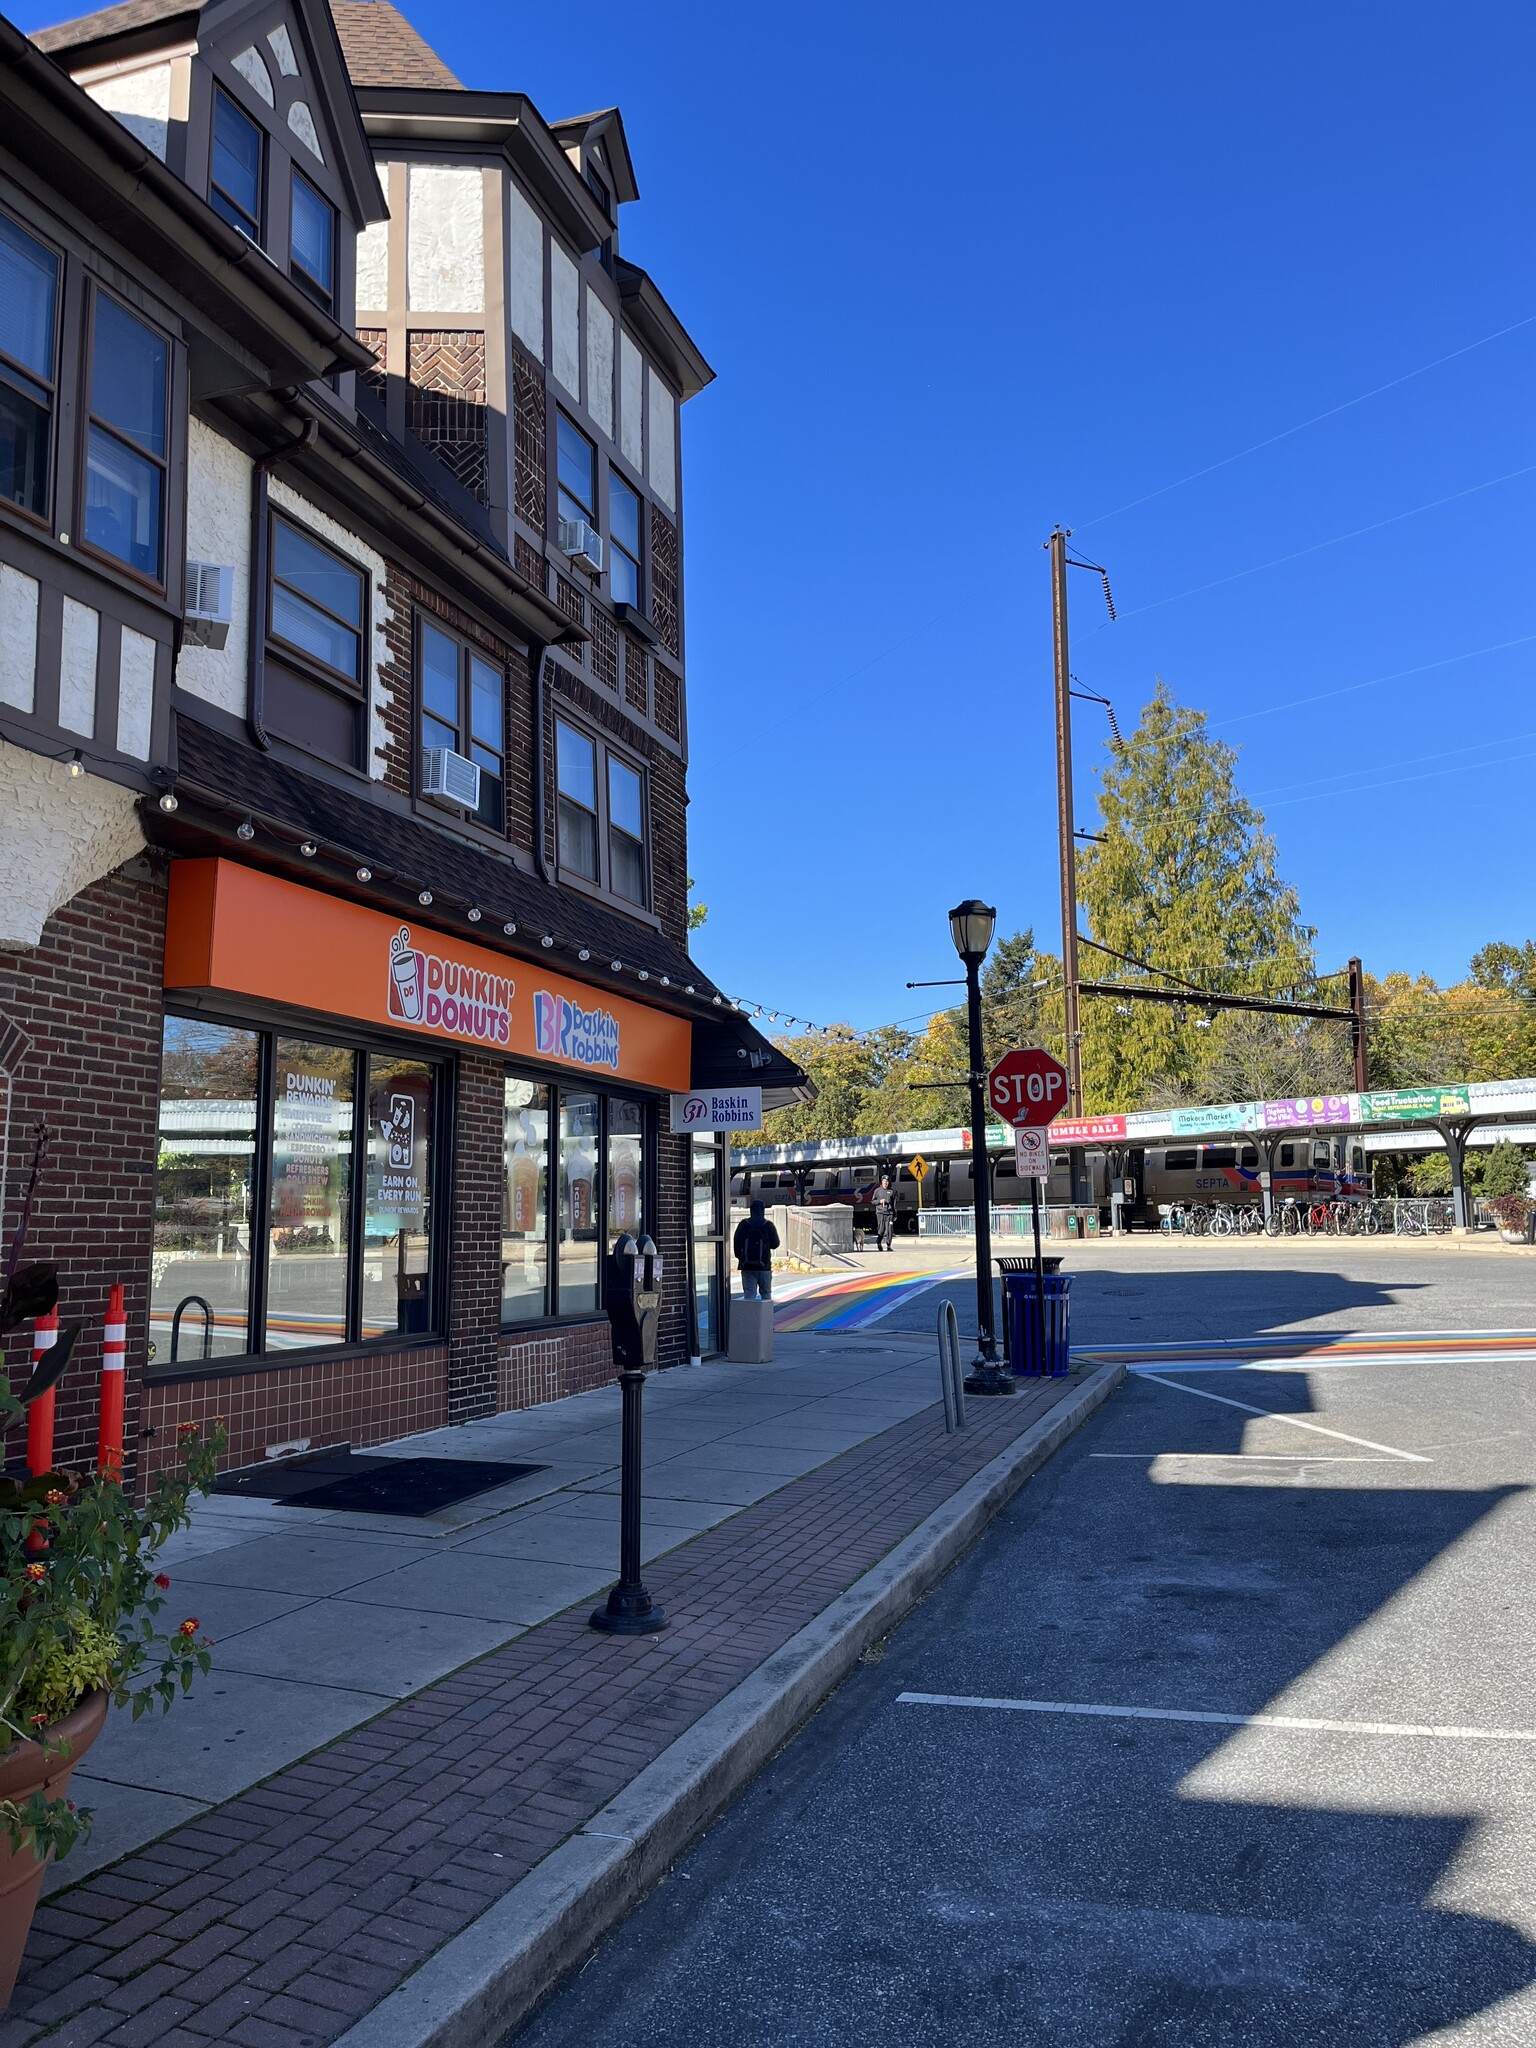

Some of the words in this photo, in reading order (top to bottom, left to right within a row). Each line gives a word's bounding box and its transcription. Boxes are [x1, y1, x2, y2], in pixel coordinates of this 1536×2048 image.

[427, 957, 514, 1010] DUNKIN'
[427, 993, 509, 1042] DONUTS
[573, 1001, 619, 1042] baskin
[572, 1034, 619, 1068] robbins
[286, 1072, 337, 1095] DUNKIN'
[994, 1072, 1062, 1104] STOP
[286, 1090, 334, 1108] REWARDS
[711, 1096, 748, 1109] Baskin
[1371, 1098, 1390, 1107] Food
[1391, 1094, 1437, 1105] Truckathon
[711, 1110, 754, 1123] Robbins
[1179, 1115, 1204, 1123] Makers
[1206, 1113, 1232, 1121] Market
[1092, 1124, 1119, 1134] SALE
[285, 1132, 332, 1145] SANDWICHES
[290, 1143, 326, 1154] ESPRESSO
[293, 1154, 323, 1164] DONUTS
[285, 1164, 329, 1176] REFRESHERS
[286, 1175, 307, 1185] COLD
[308, 1175, 329, 1186] BREW
[382, 1174, 404, 1187] EARN
[405, 1176, 418, 1188] ON
[1195, 1178, 1230, 1189] SEPTA
[377, 1188, 403, 1201] EVERY
[405, 1190, 422, 1202] RUN
